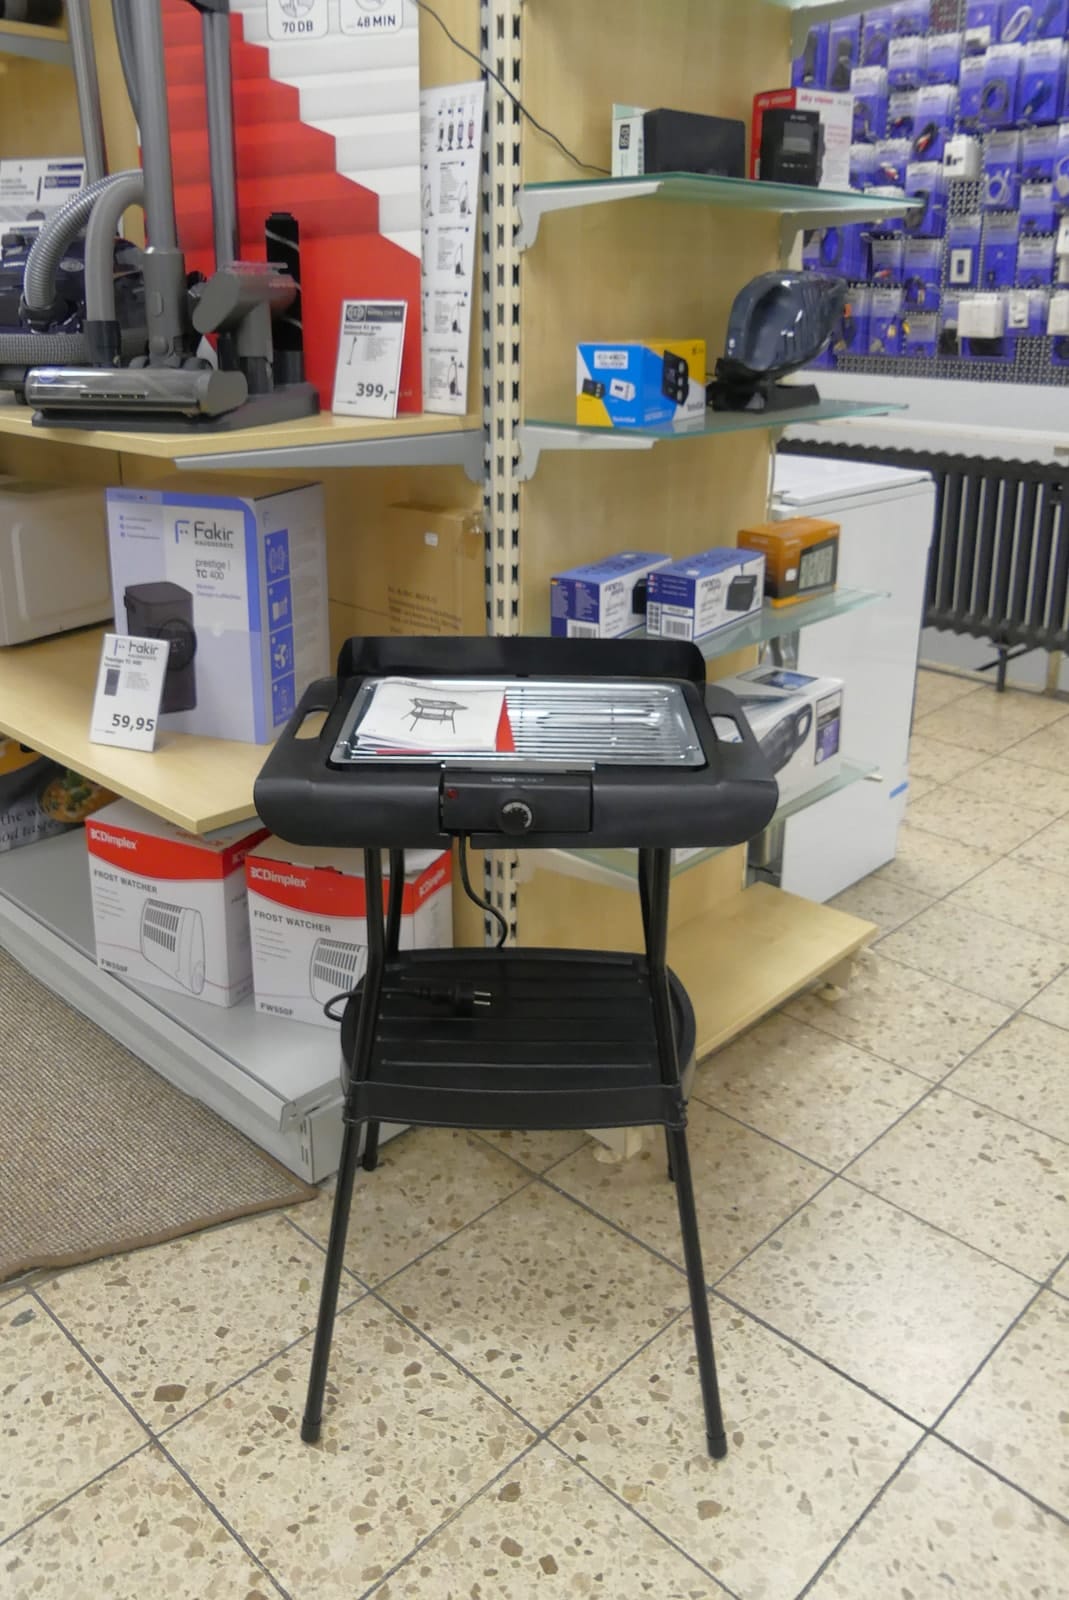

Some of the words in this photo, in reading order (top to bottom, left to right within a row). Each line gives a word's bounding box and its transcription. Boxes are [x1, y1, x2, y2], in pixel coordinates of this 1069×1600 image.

[283, 21, 296, 33] 70
[298, 20, 313, 32] DB
[357, 16, 371, 28] 48
[373, 15, 396, 27] MIN
[194, 521, 234, 541] Fakir
[196, 569, 208, 579] TC
[112, 713, 155, 732] 59,95
[94, 868, 119, 883] FROST
[120, 875, 158, 893] WATCHER
[253, 909, 283, 924] FROST
[286, 917, 332, 933] WATCHER
